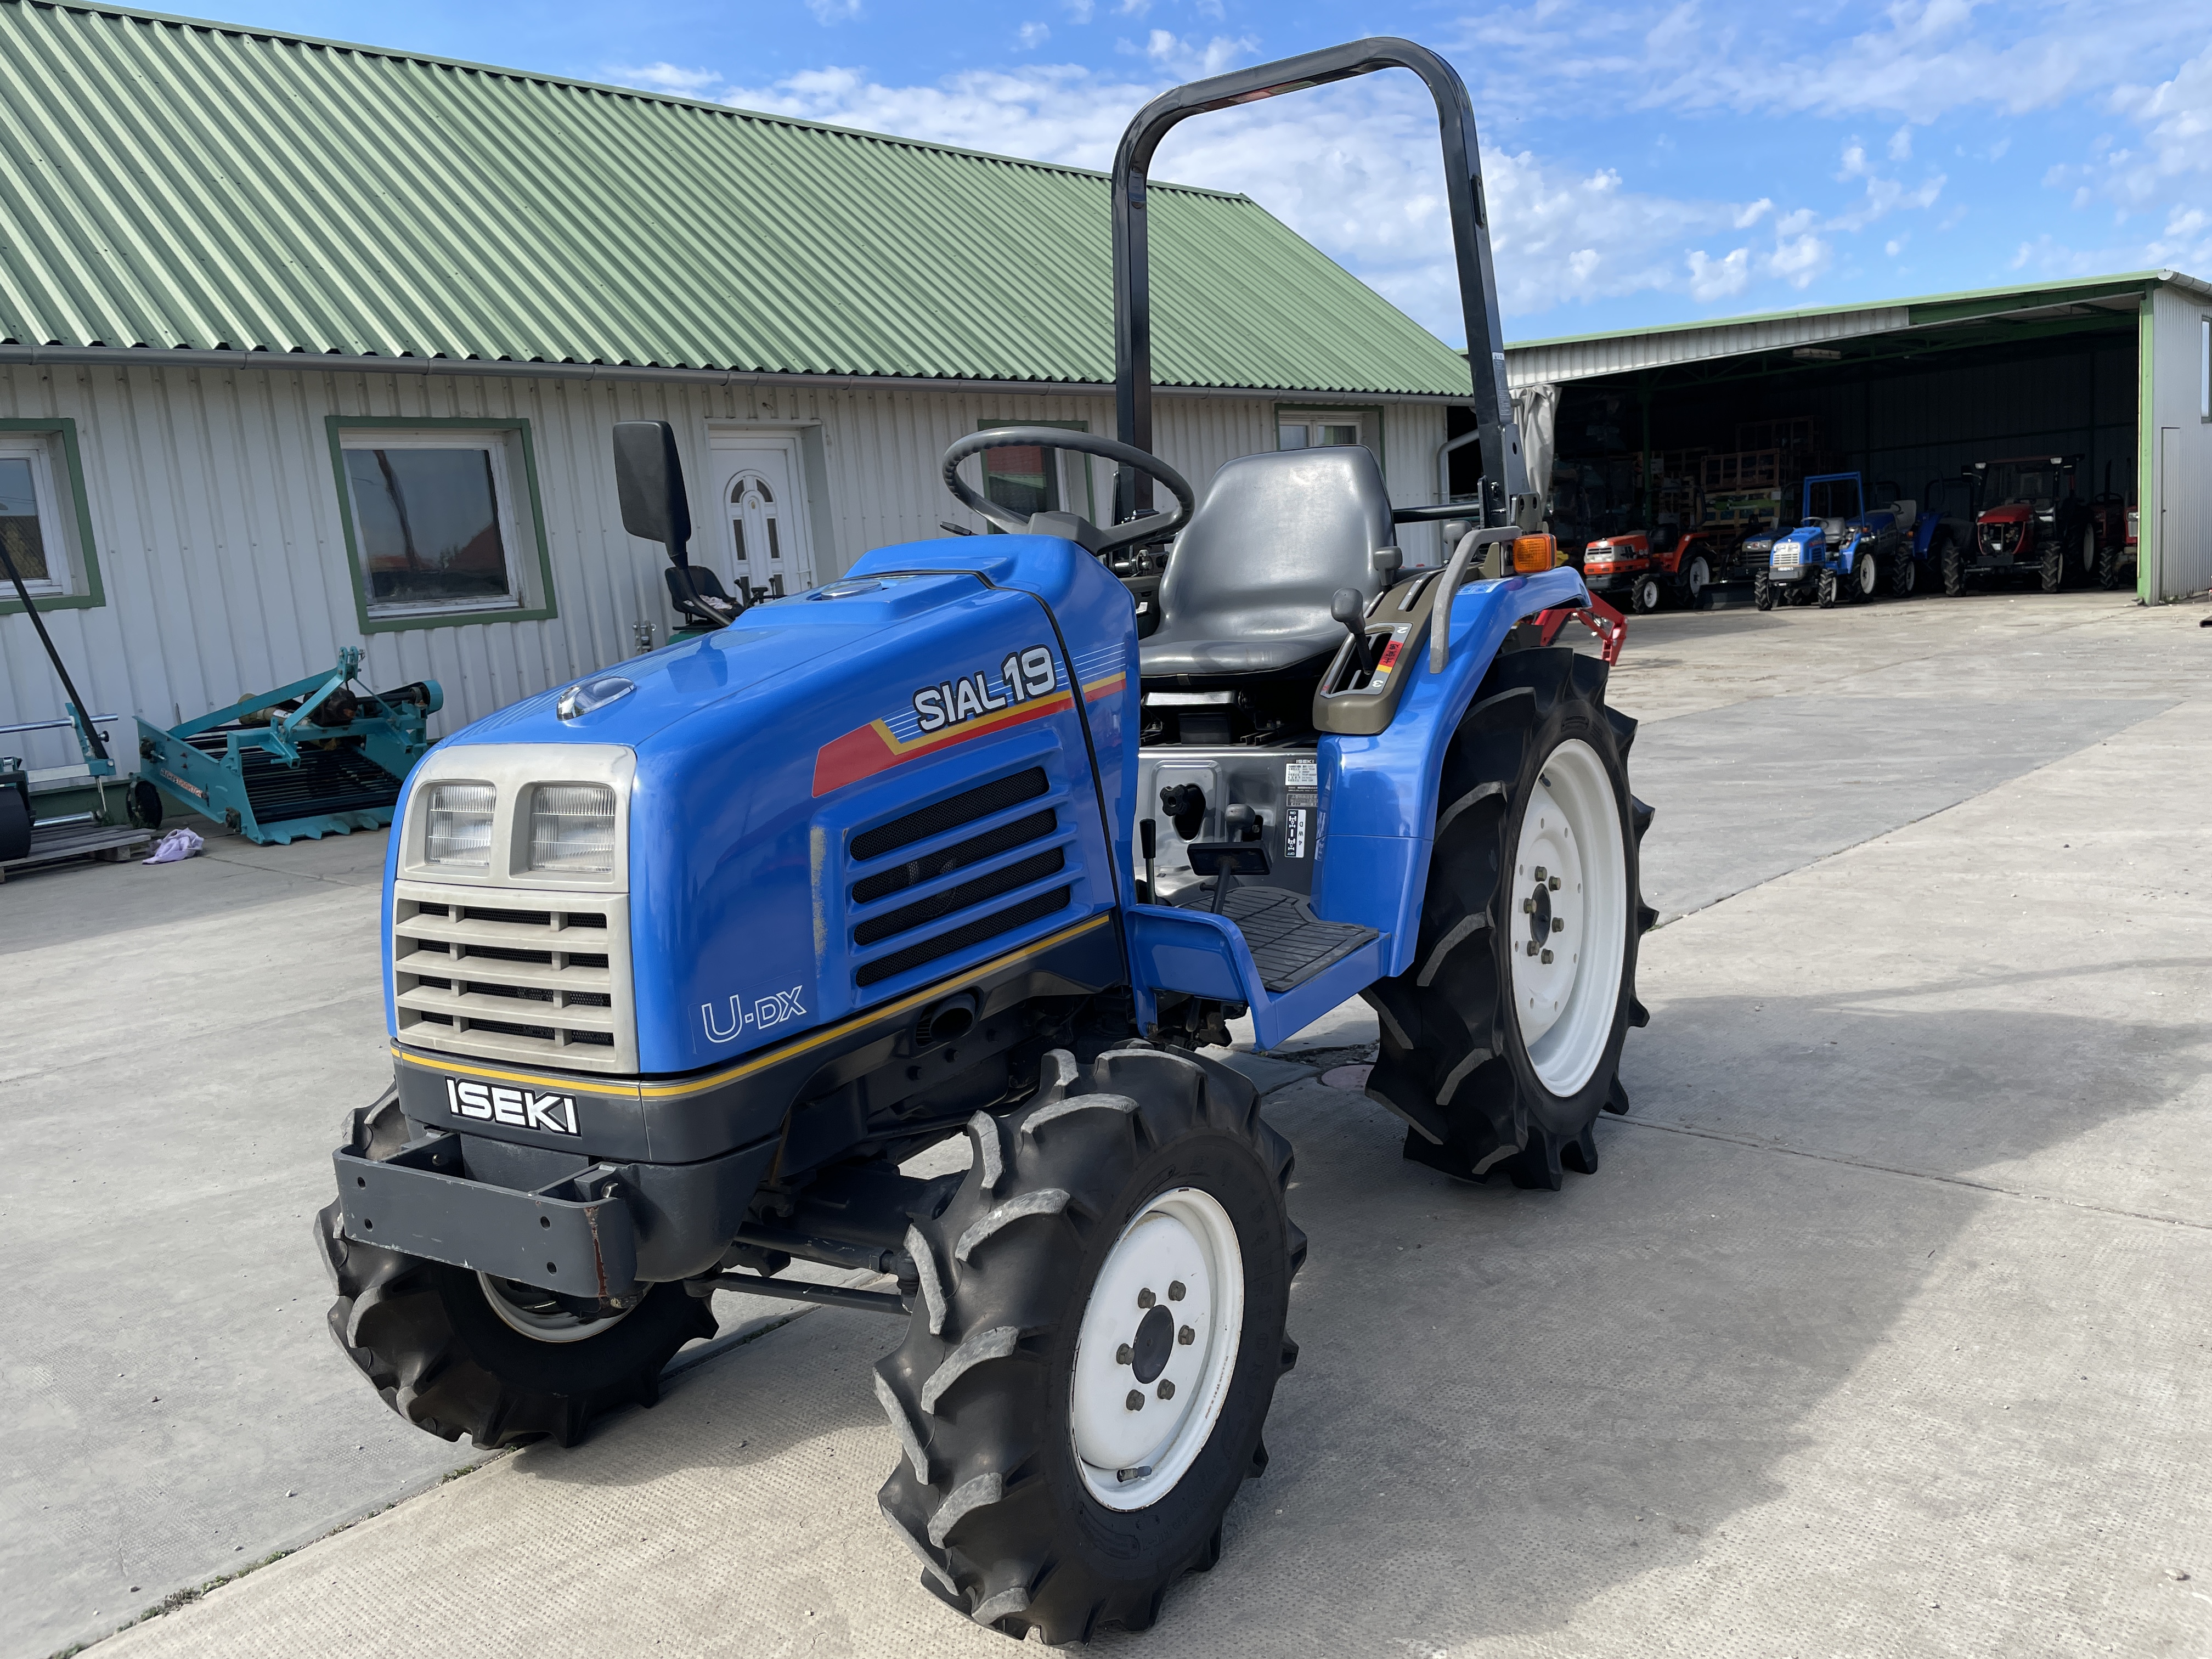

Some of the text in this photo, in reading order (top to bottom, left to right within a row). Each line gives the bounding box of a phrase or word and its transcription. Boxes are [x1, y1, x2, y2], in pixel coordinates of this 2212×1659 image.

[915, 646, 1056, 731] SIAL 19
[445, 1076, 578, 1135] ISEKI
